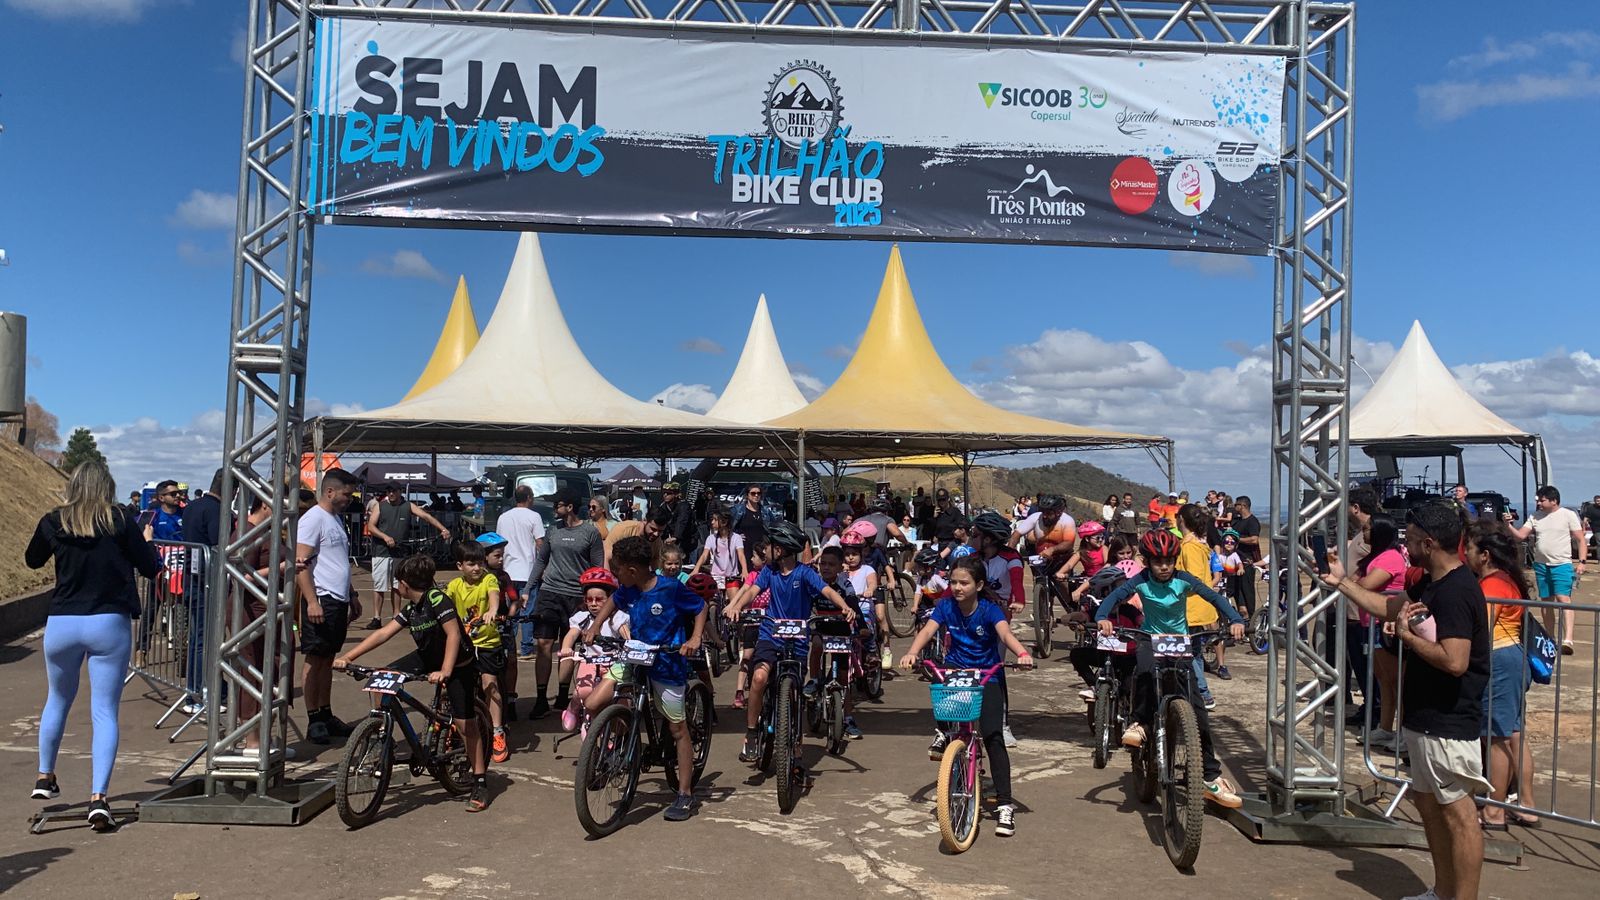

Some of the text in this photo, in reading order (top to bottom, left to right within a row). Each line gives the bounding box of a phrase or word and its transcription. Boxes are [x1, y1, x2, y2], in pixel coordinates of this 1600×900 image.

[354, 55, 597, 130] SEJAM
[1001, 87, 1072, 108] SICOOB
[788, 112, 815, 126] BIKE
[1031, 110, 1071, 122] Copersul
[1172, 118, 1216, 127] NUTRENDS
[787, 126, 815, 138] CLUB
[340, 112, 607, 177] BEM VINDOS
[706, 124, 885, 185] TRILHÃO
[732, 174, 883, 207] BIKE CLUB
[1120, 180, 1157, 189] MinasMaster
[987, 195, 1086, 217] Três Pontas
[834, 202, 882, 227] 2025
[1000, 216, 1023, 224] UNIÃO
[717, 458, 779, 468] SENSE
[777, 626, 801, 634] 259
[1157, 643, 1186, 652] 046
[370, 678, 395, 689] 201
[947, 677, 974, 687] 263
